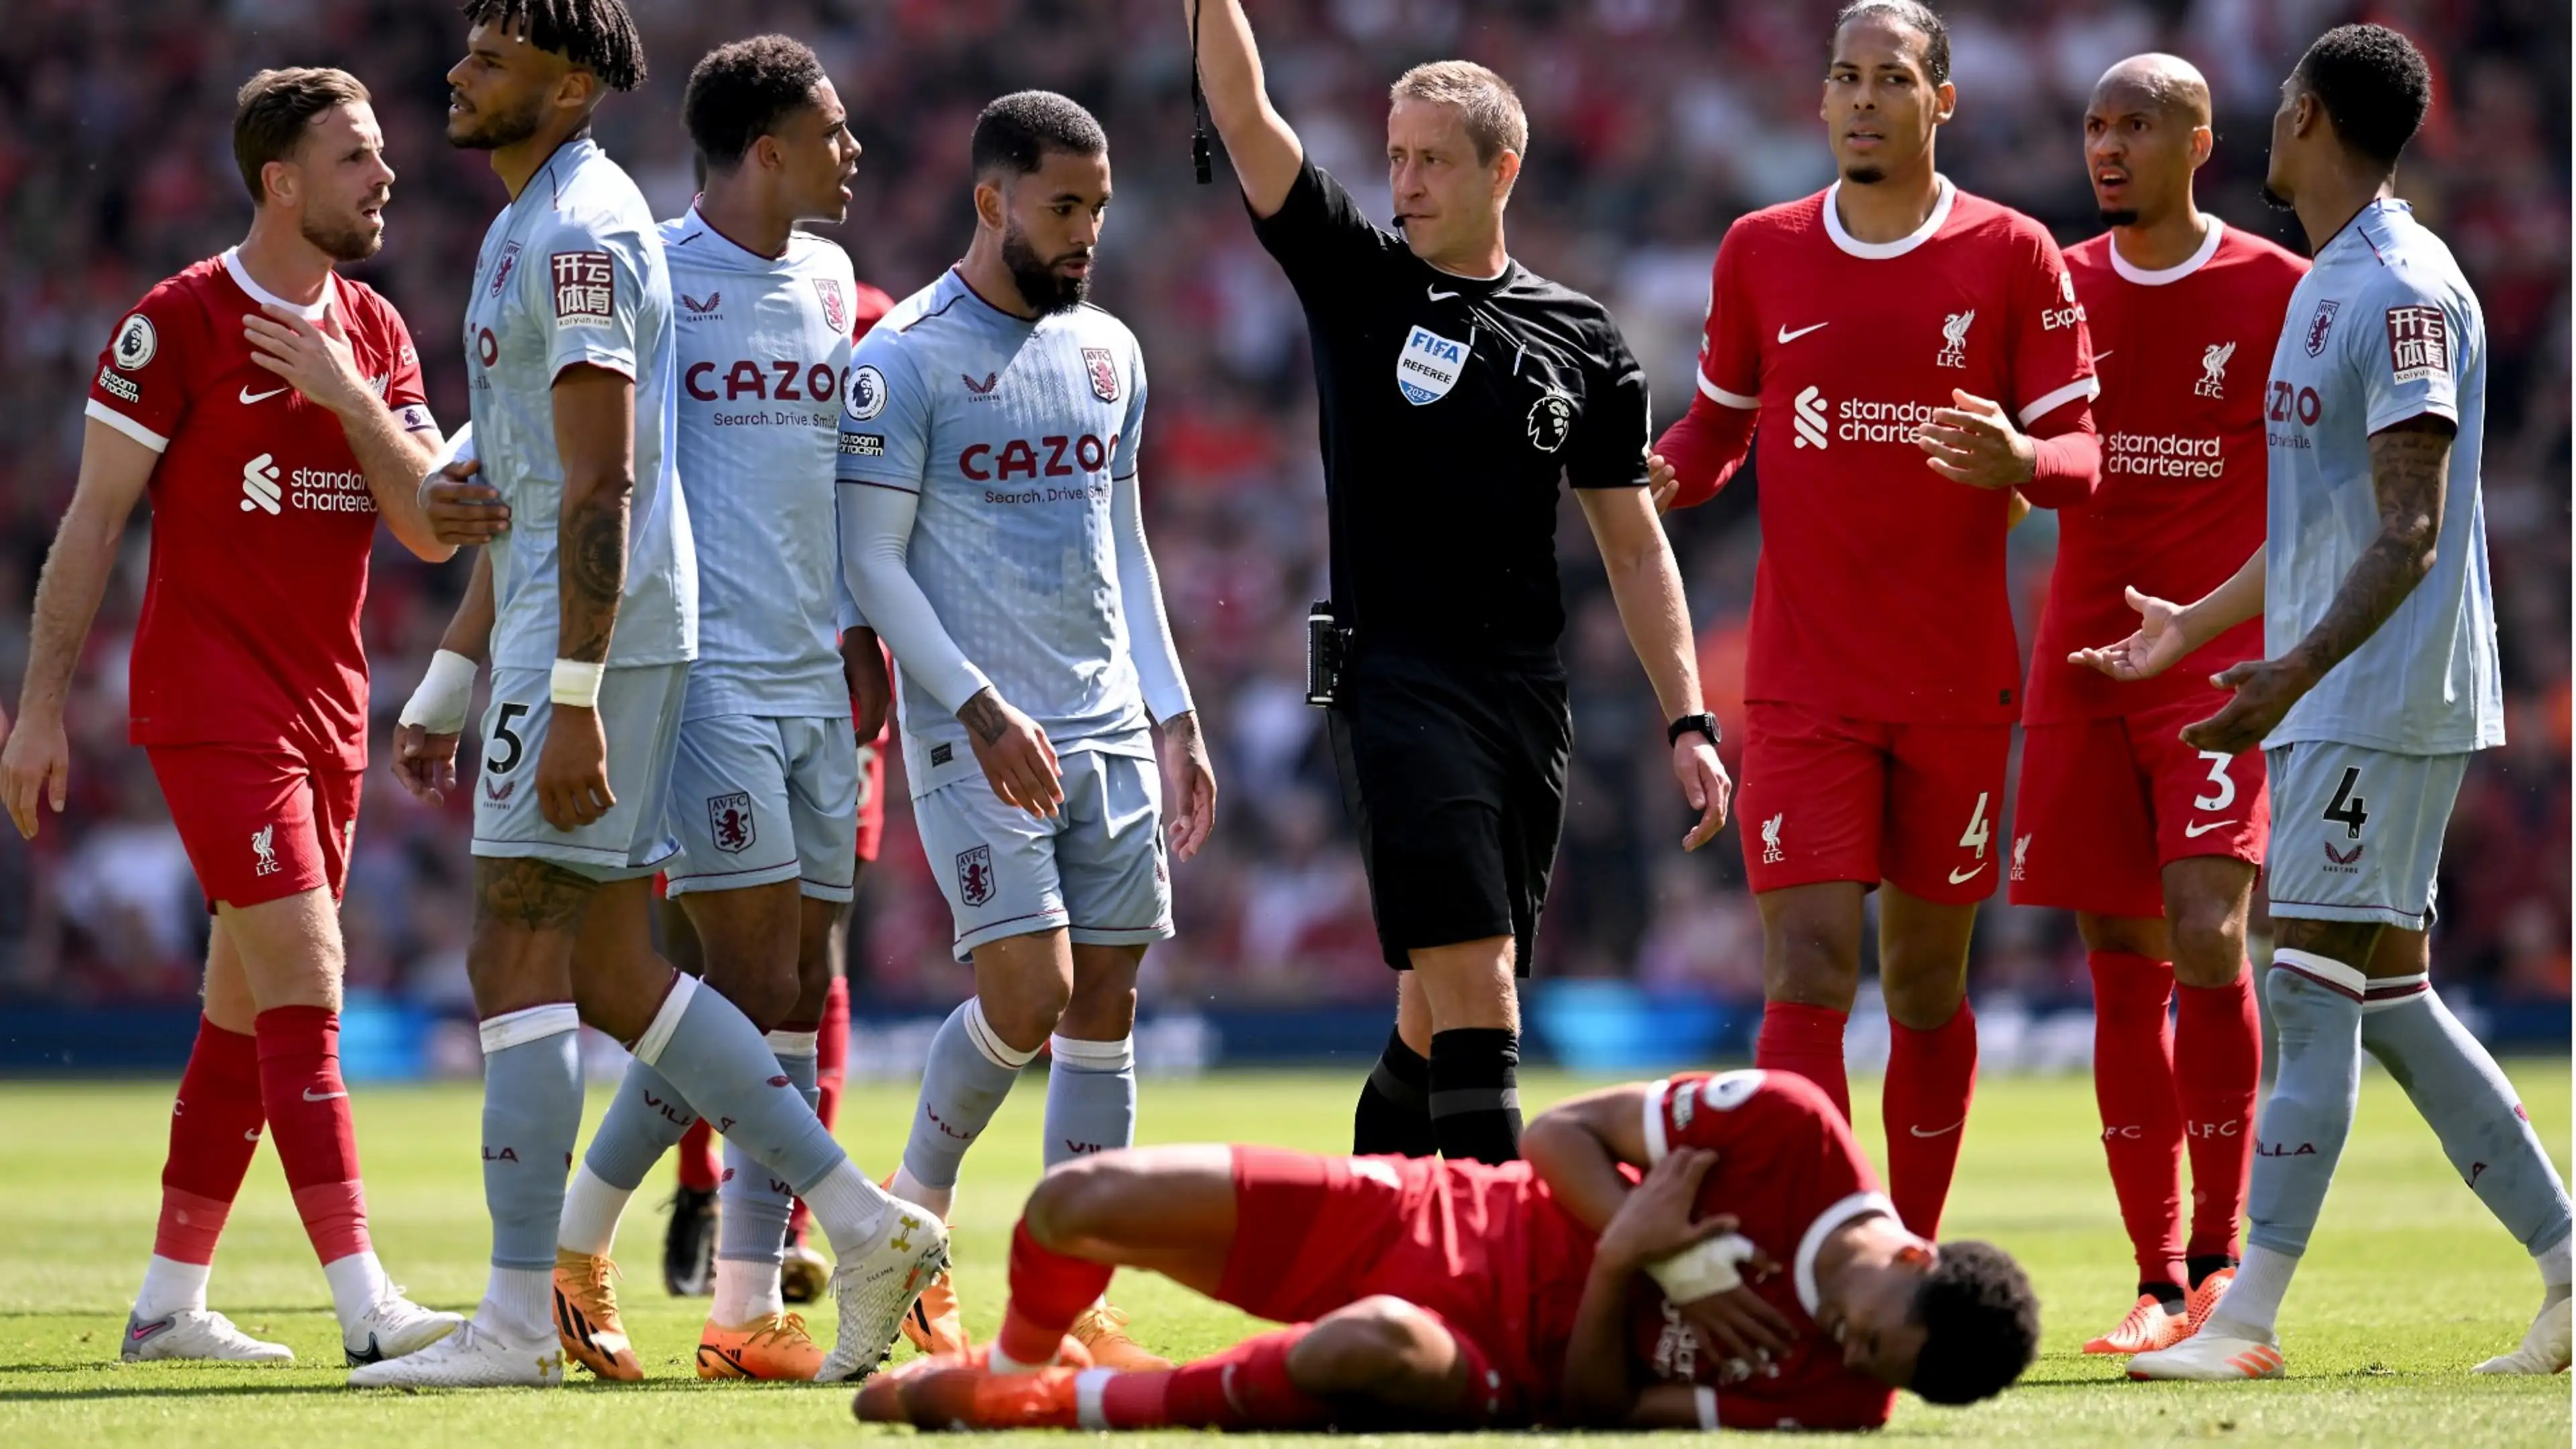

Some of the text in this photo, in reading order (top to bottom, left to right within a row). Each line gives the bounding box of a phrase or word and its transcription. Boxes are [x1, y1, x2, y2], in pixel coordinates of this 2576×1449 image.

[553, 254, 610, 284] 开云
[557, 284, 611, 315] 体育
[2389, 309, 2443, 338] 开云
[1411, 331, 1459, 364] FIFA
[2394, 338, 2445, 369] 体育
[110, 374, 138, 392] room
[1403, 358, 1452, 384] REFEREE
[106, 382, 140, 403] racism
[1407, 386, 1432, 400] 2023
[1839, 397, 1937, 423] standa
[849, 435, 879, 447] room
[1839, 420, 1923, 444] charte
[2108, 431, 2220, 458] standard
[847, 445, 883, 457] racism
[2108, 452, 2225, 478] chartered
[486, 702, 530, 775] 5
[2194, 750, 2236, 811] 3
[712, 796, 747, 811] AVFC
[2322, 766, 2370, 841] 4
[1959, 792, 1990, 859] 4
[960, 849, 987, 867] AVFC
[644, 1089, 694, 1126] VILL
[926, 1102, 987, 1140] VILL
[2188, 1119, 2237, 1138] LFC
[482, 1146, 519, 1163] LA
[2255, 1139, 2316, 1157] ILLA
